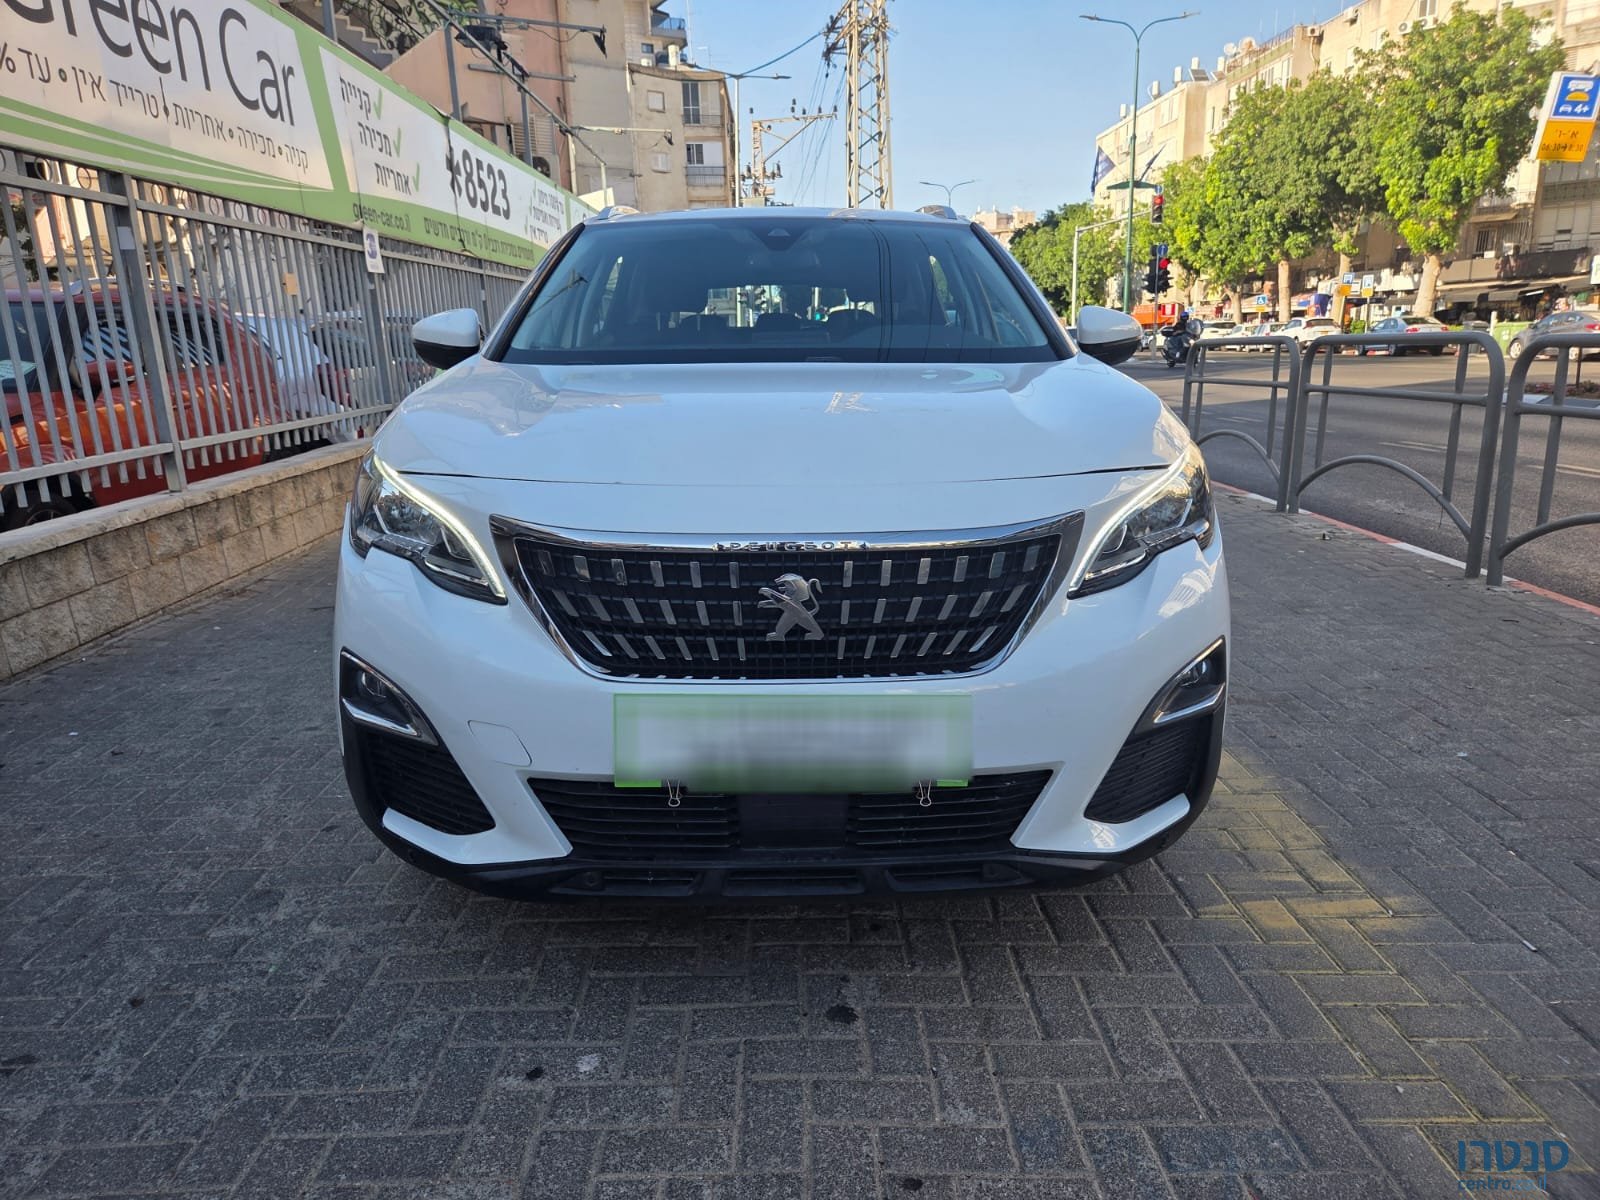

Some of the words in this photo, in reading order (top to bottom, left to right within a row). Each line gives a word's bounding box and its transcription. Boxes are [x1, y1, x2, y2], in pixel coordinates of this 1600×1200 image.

[2, 0, 212, 92] een
[218, 7, 296, 127] Car
[17, 47, 52, 84] עד
[71, 65, 107, 103] אין
[108, 79, 160, 119] טרייד
[339, 76, 371, 121] קנייה
[172, 102, 227, 143] אחריות
[357, 121, 393, 158] מכירה
[237, 126, 276, 158] מכירה
[284, 144, 309, 174] קניה
[374, 162, 412, 196] אחריות
[728, 540, 853, 553] PEUGEOT
